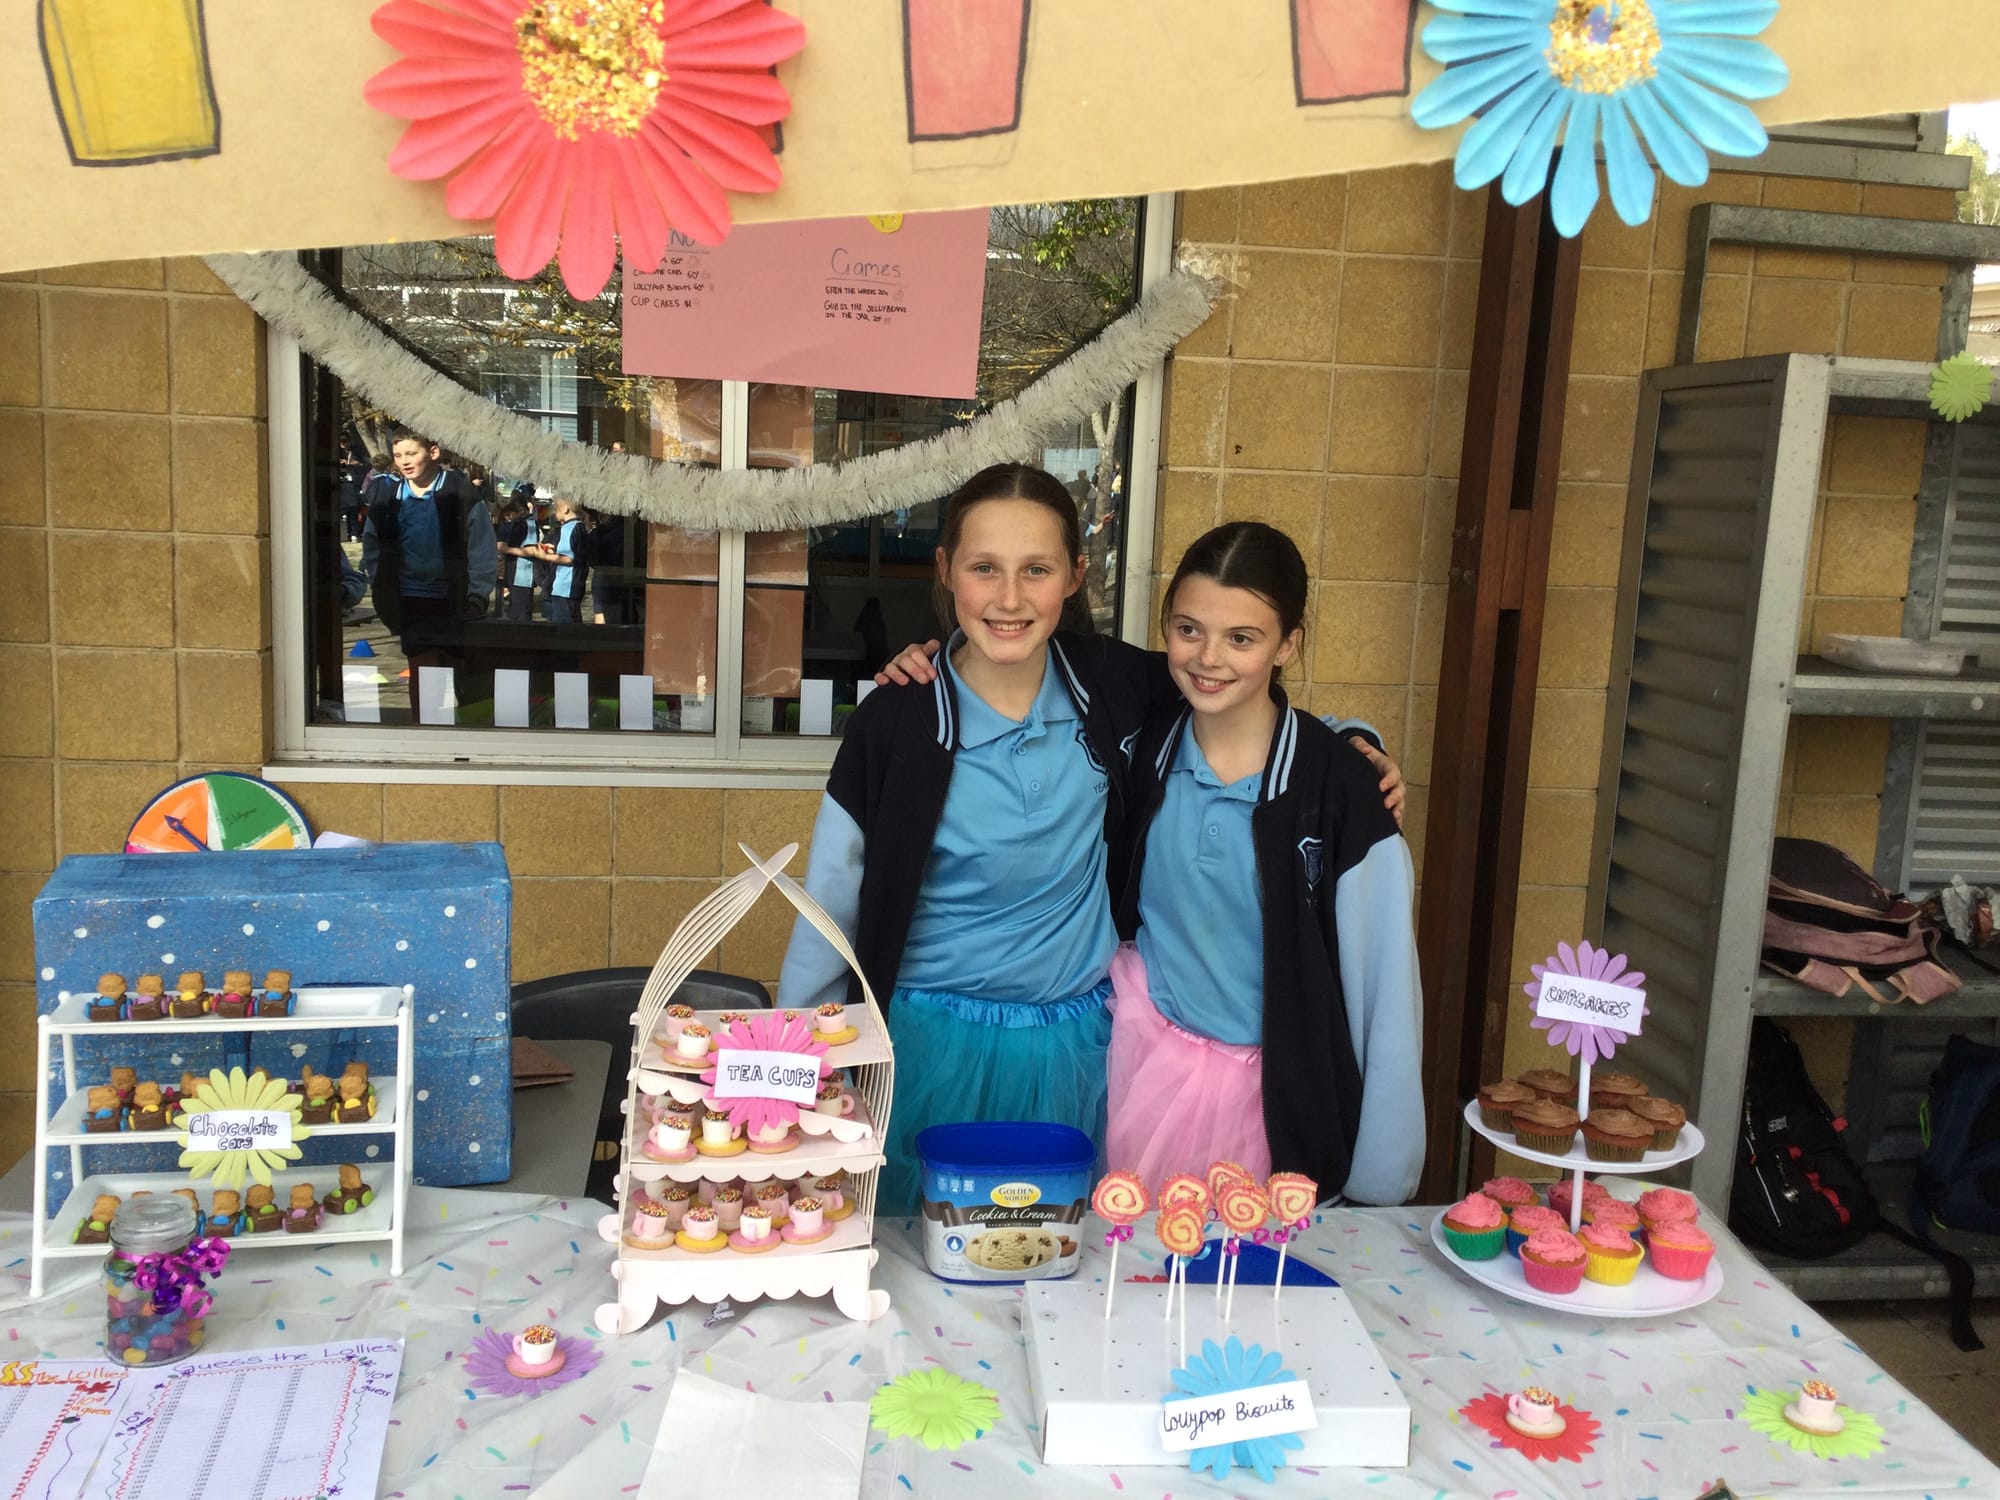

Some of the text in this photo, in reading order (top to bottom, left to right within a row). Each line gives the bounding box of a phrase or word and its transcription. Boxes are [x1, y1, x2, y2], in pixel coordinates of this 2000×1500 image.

[831, 248, 901, 277] Games
[631, 295, 650, 306] CUP
[653, 299, 680, 308] CAKES
[824, 299, 848, 310] GUESS
[1545, 986, 1631, 1018] CUPCAKES
[727, 1065, 816, 1089] TEA CUPS
[189, 1114, 278, 1136] Chocolate
[217, 1136, 254, 1150] cars
[998, 1187, 1034, 1195] GOLDEN
[969, 1206, 1056, 1221] Cookies & Cream
[173, 1342, 398, 1376] Guess the Lollies
[66, 1366, 129, 1380] Lollies
[1235, 1394, 1295, 1421] Biscuits
